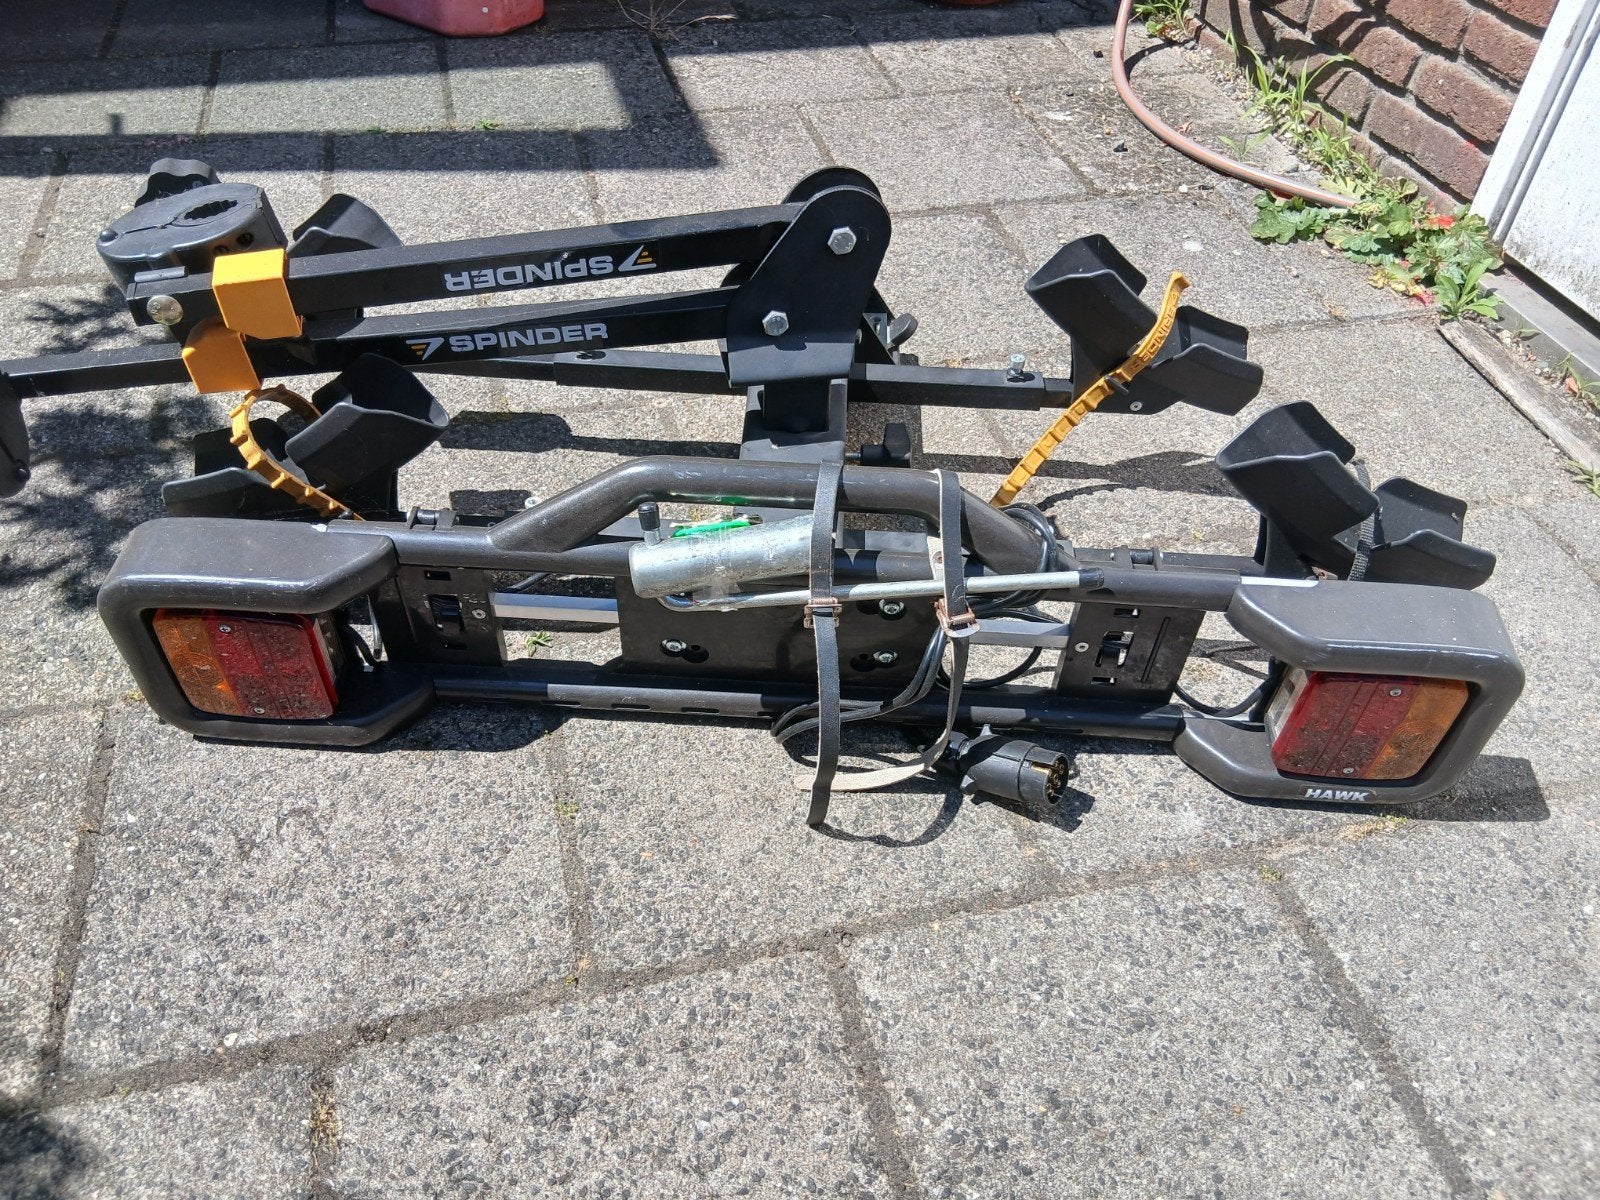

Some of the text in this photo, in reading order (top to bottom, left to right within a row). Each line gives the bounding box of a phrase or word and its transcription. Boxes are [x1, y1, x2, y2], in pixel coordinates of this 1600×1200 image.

[443, 255, 614, 292] SPINDER
[449, 322, 609, 353] SPINDER
[1304, 788, 1369, 801] HAWK
